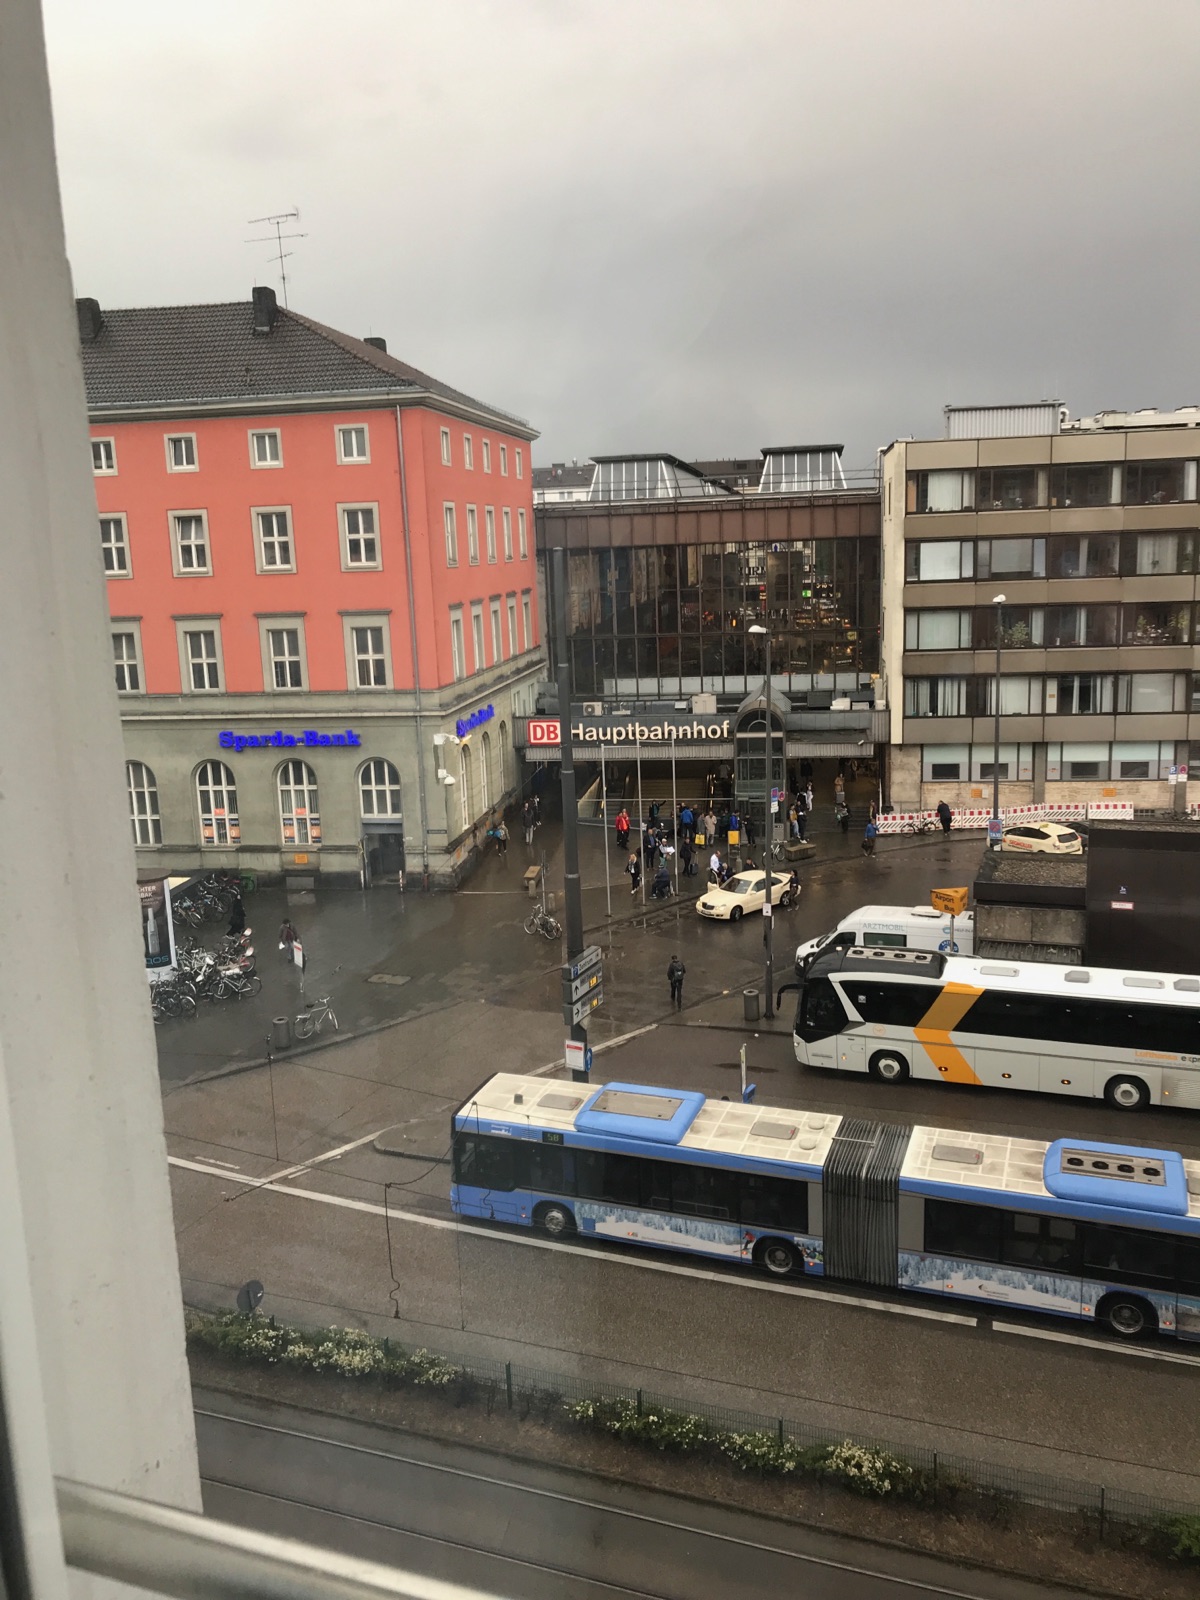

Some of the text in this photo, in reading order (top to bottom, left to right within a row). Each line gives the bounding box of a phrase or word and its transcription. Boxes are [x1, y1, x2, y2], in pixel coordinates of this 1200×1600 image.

[532, 720, 729, 744] DB Hauptbahnhof
[219, 730, 361, 751] Sparda-Bank
[935, 893, 955, 904] Airport
[944, 904, 955, 912] Bus
[862, 922, 906, 932] ARZTMOBIL
